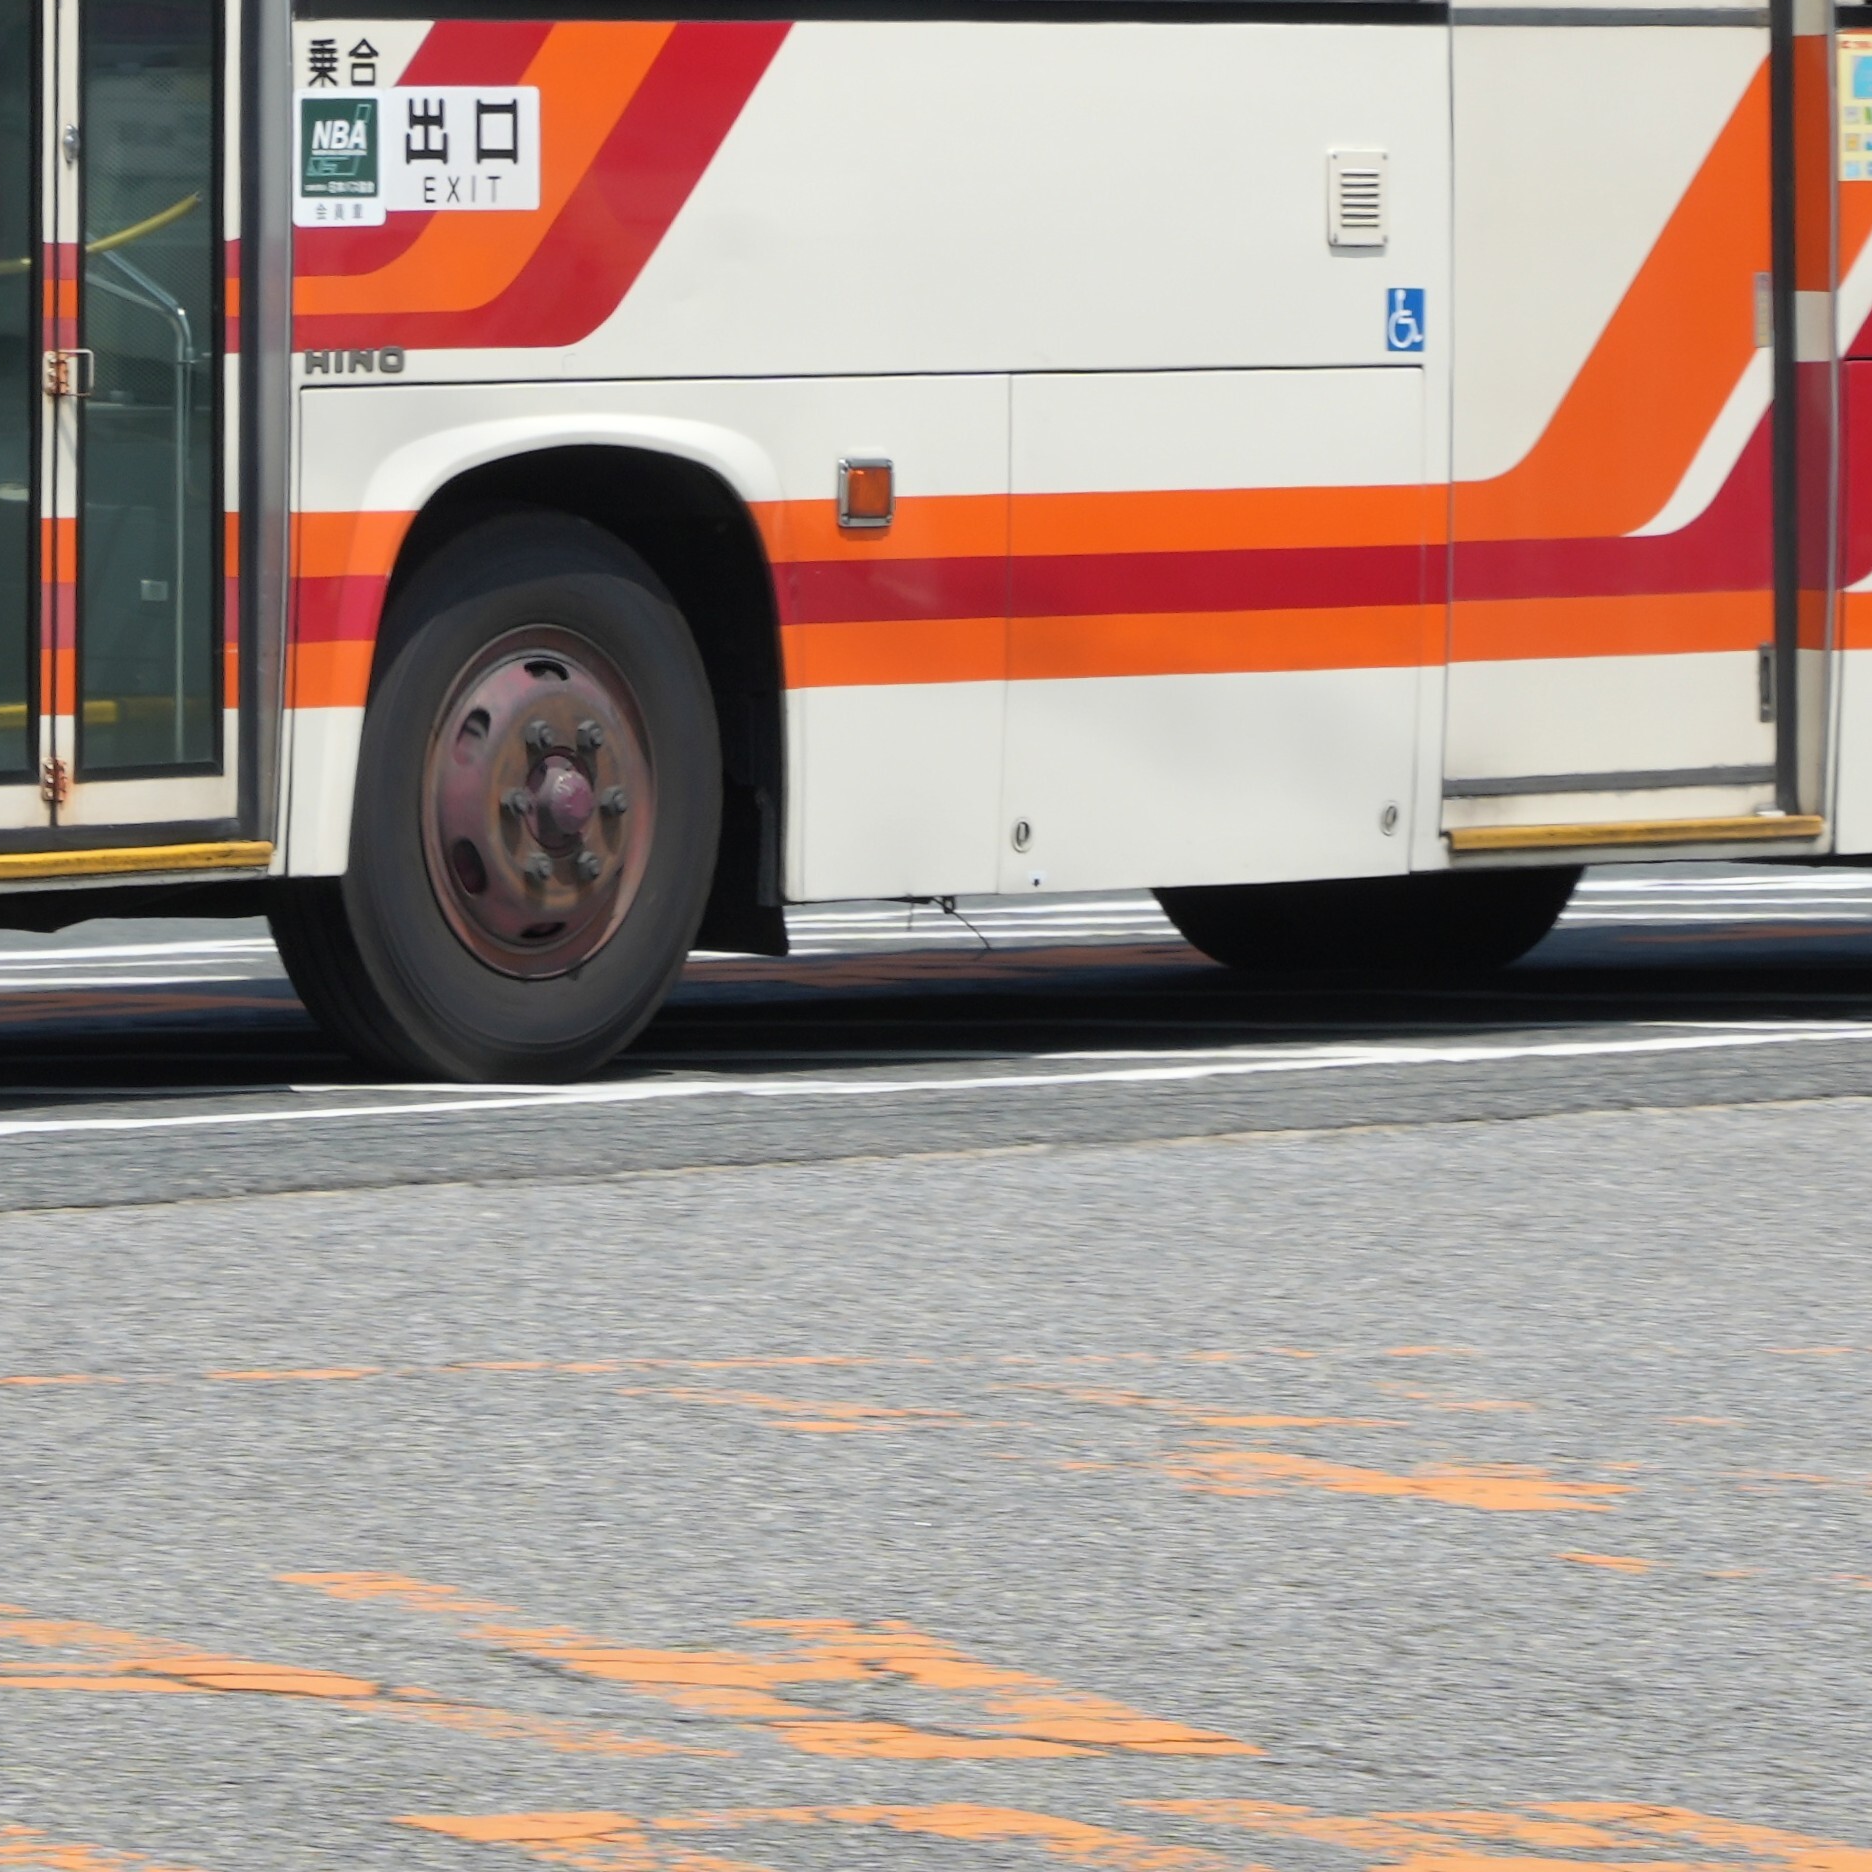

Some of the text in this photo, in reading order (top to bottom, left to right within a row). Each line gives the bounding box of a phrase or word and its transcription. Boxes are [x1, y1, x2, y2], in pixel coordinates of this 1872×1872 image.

[307, 37, 380, 88] 乗合
[311, 119, 368, 151] NBA
[405, 97, 519, 165] 出口
[423, 175, 502, 204] EXIT
[304, 346, 405, 375] HINO
